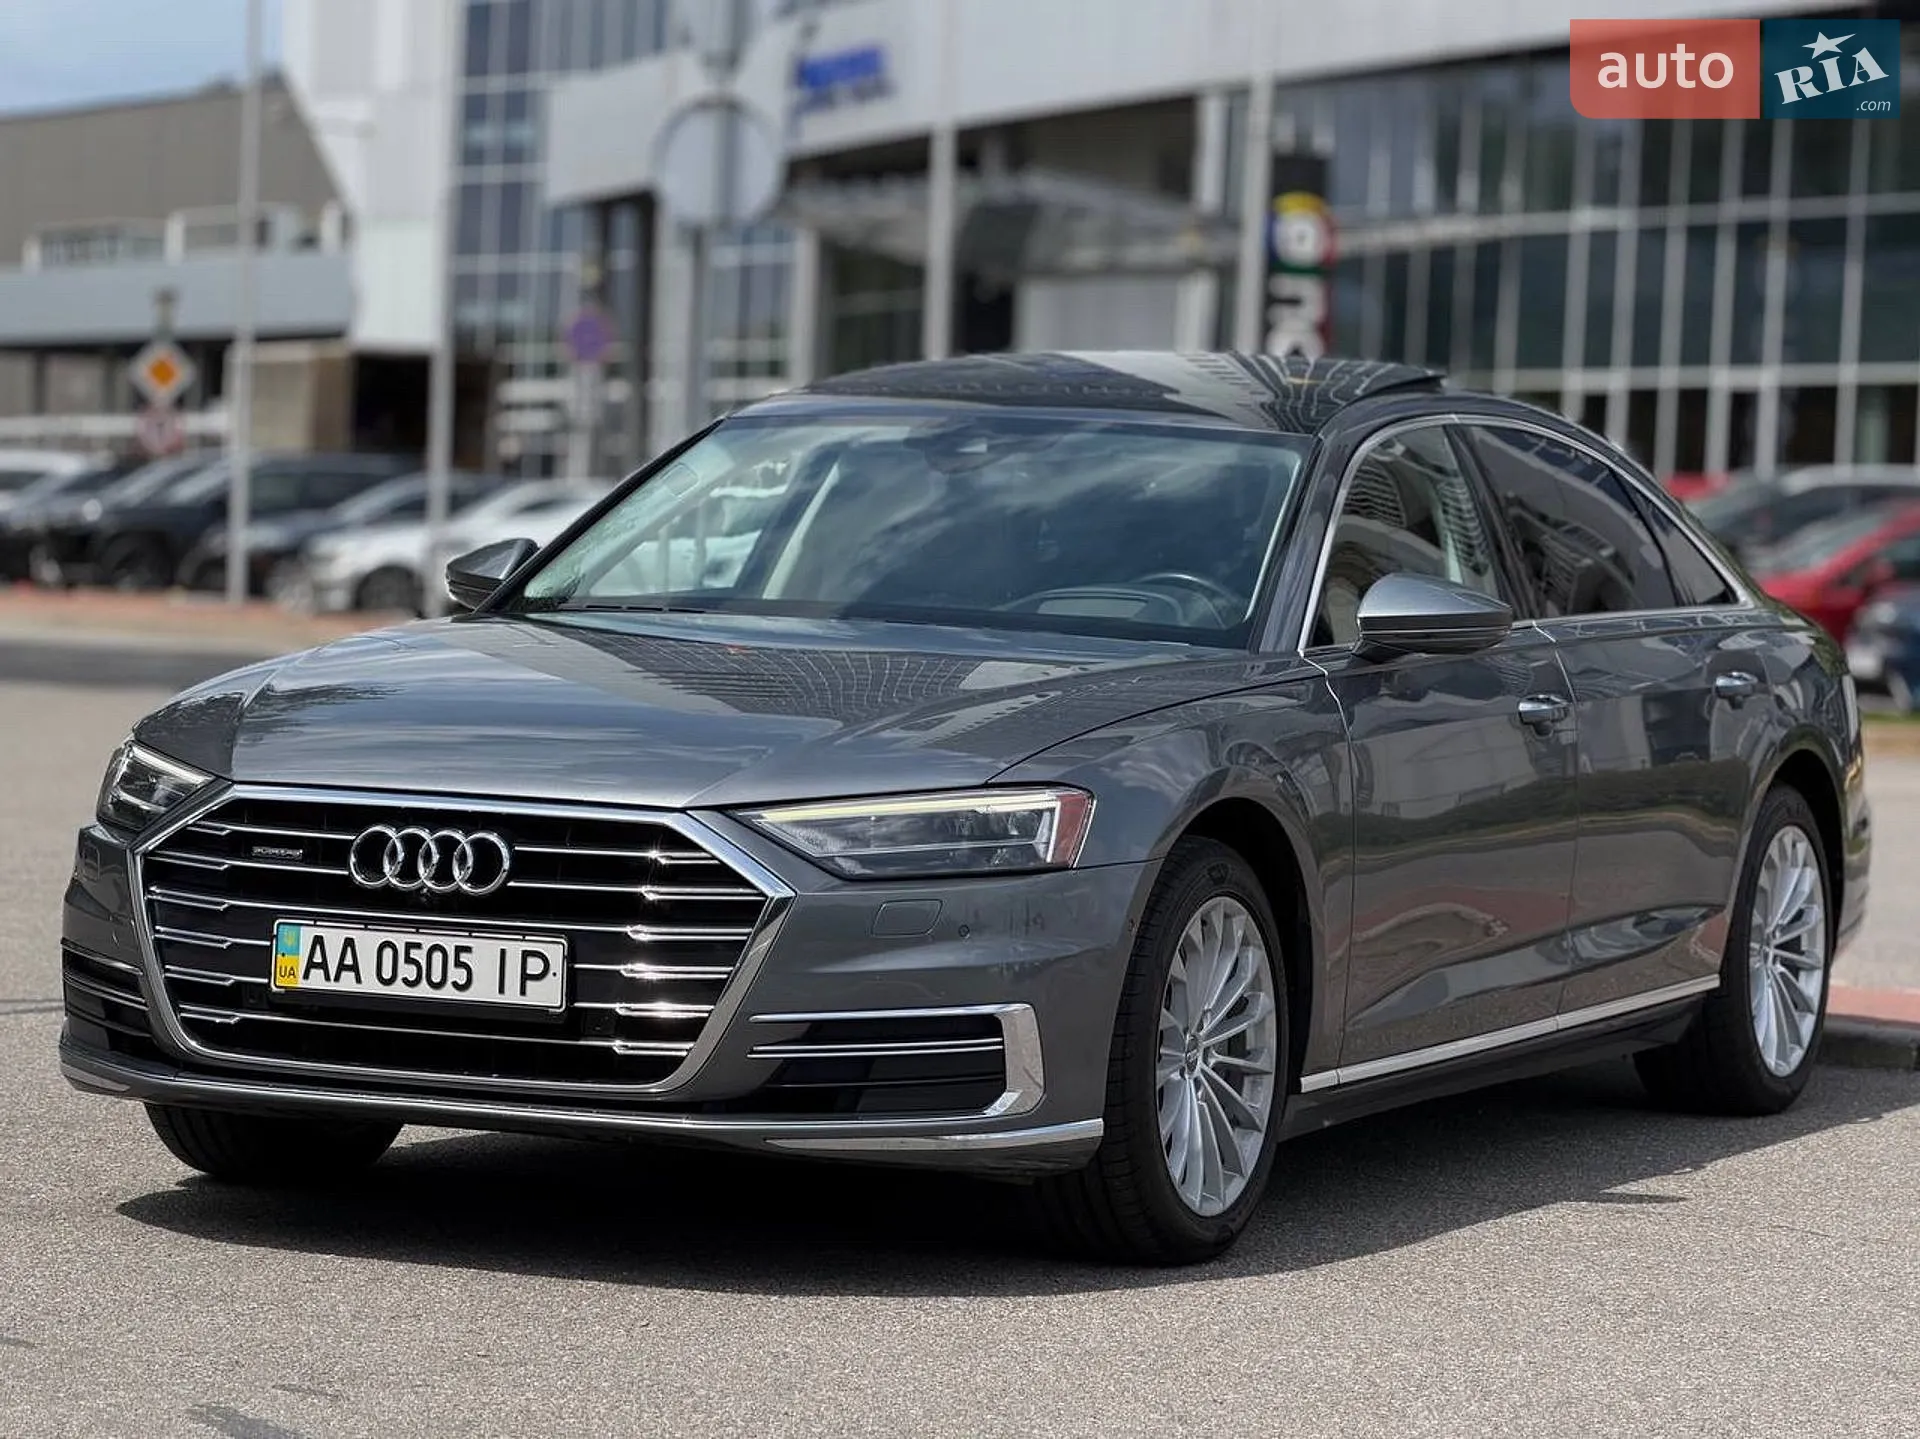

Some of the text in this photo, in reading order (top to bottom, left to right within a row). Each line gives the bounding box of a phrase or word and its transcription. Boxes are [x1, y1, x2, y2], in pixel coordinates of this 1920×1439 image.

[278, 963, 297, 979] UA
[302, 934, 551, 996] AA 0505 IP
